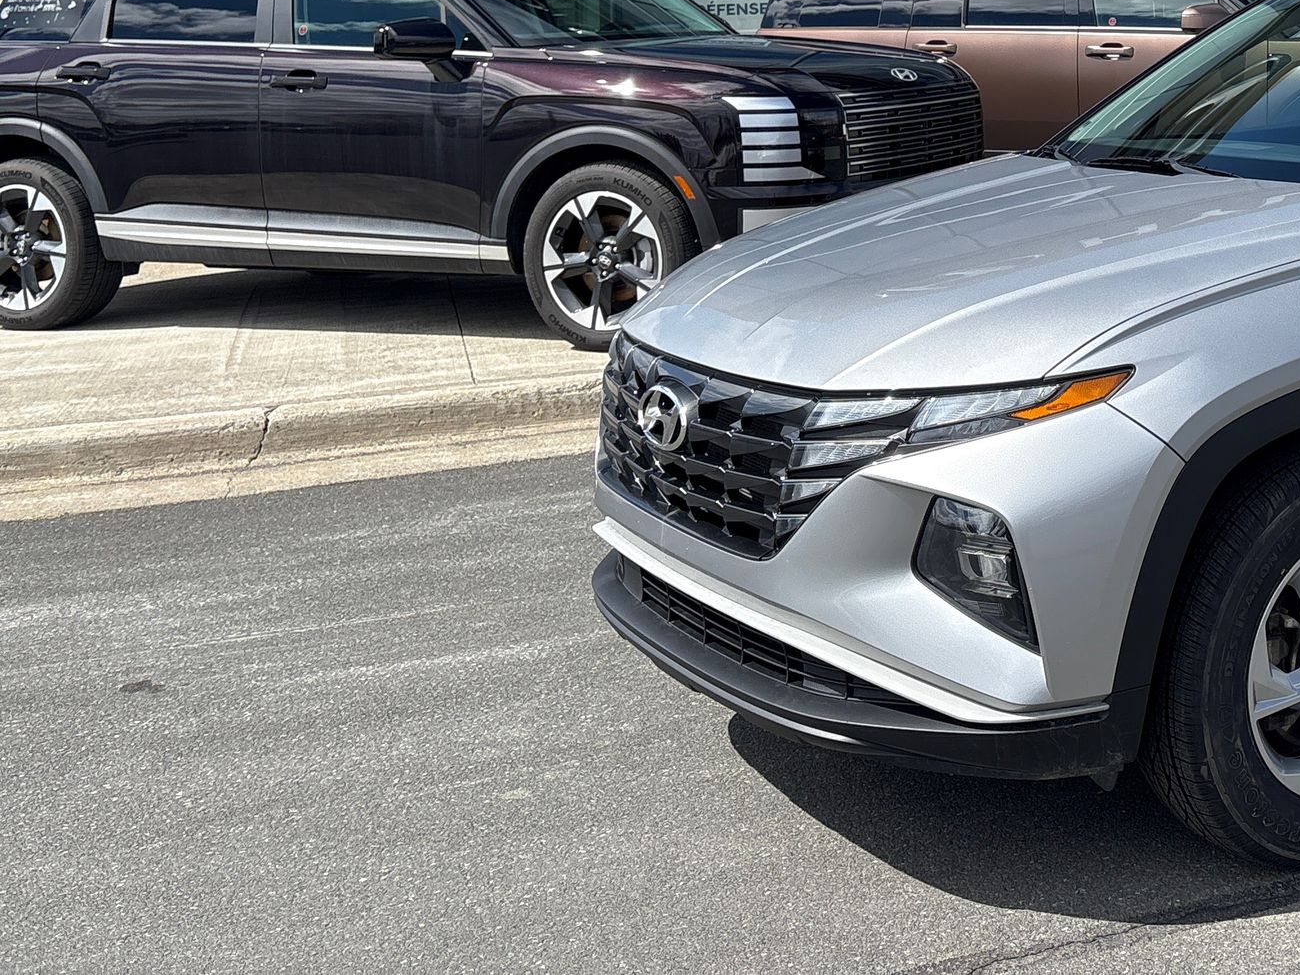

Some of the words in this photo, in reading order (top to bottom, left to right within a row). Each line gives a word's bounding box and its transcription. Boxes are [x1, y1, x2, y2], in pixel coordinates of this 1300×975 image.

[700, 1, 769, 16] ÉFENSE
[612, 177, 653, 207] KUMHO
[549, 313, 587, 344] KUMHO
